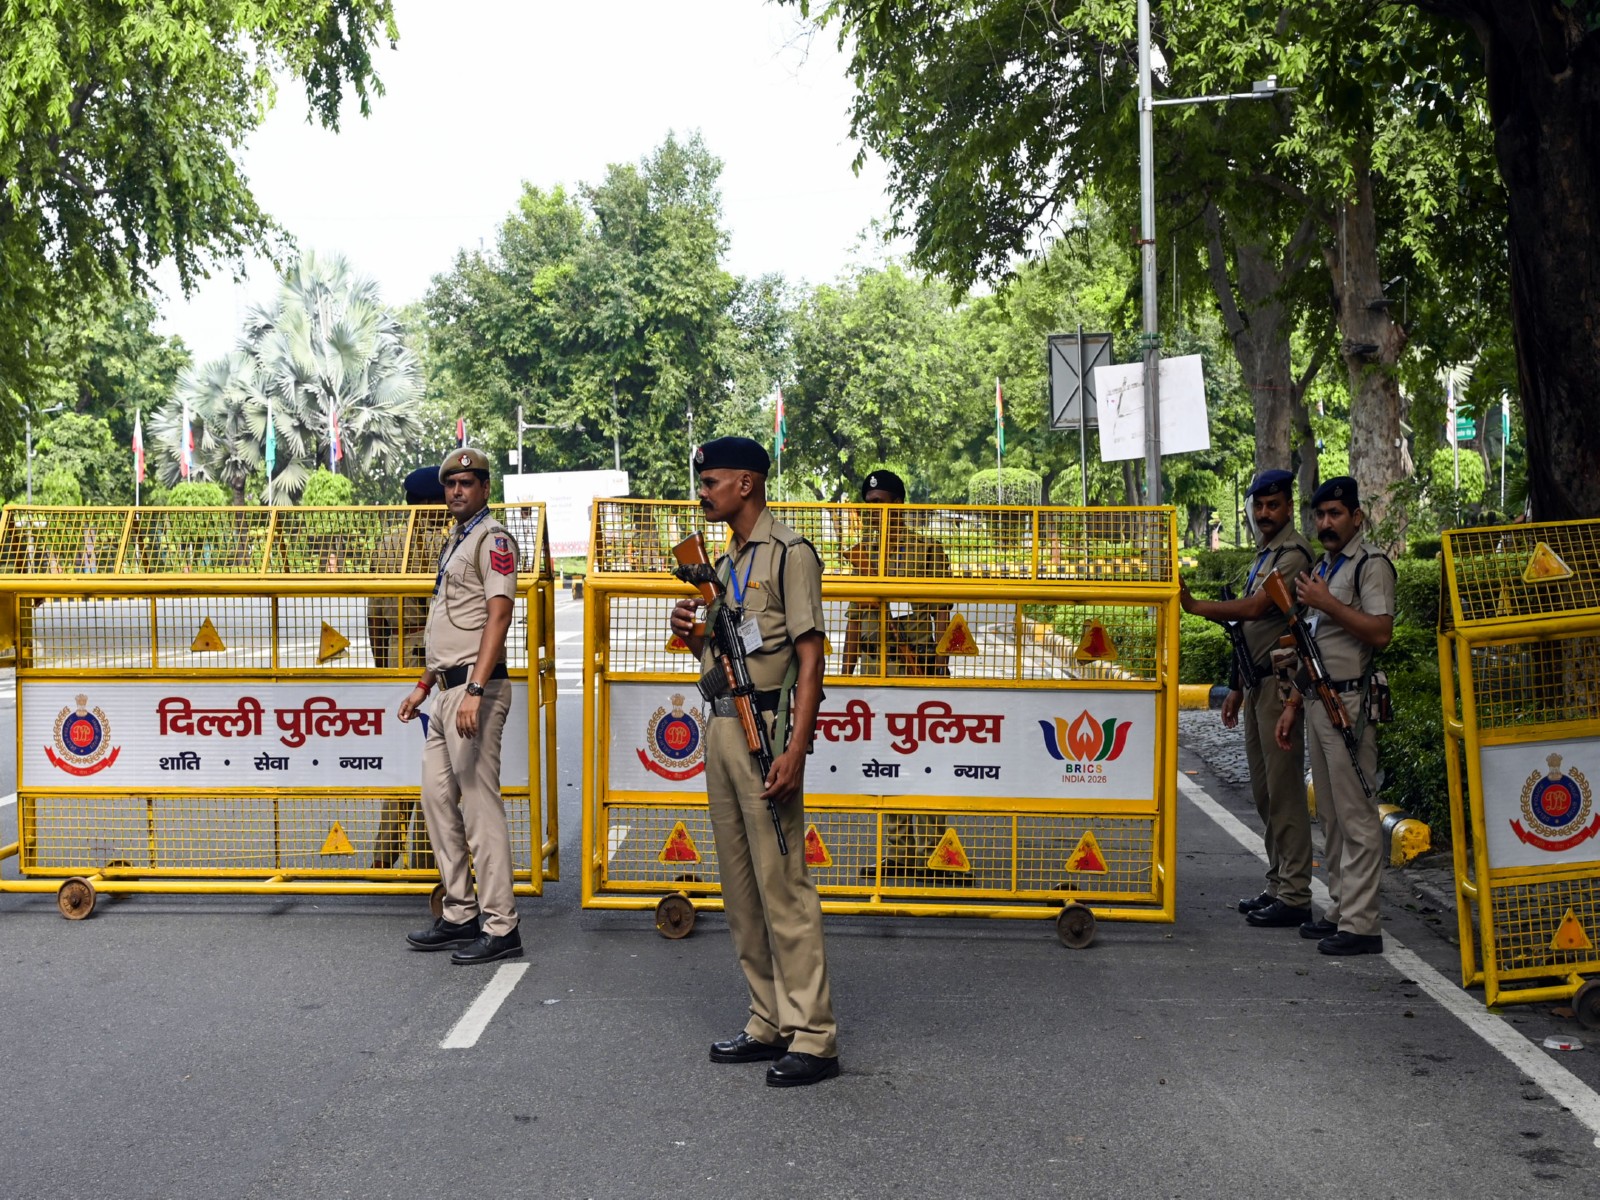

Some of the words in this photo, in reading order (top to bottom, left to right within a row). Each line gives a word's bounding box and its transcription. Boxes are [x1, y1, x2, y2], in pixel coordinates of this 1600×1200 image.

[156, 696, 265, 737] दिल्ली
[274, 696, 385, 748] पुलिस
[813, 699, 876, 742] ल्ली
[885, 701, 1005, 755] पुलिस
[159, 751, 201, 770] शांति
[254, 752, 289, 771] सेवा
[339, 756, 383, 770] न्याय
[862, 758, 901, 778] सेवा
[954, 764, 1001, 780] न्याय
[1066, 764, 1103, 773] BRICS
[1062, 775, 1086, 783] INDIA
[1087, 775, 1107, 783] 2026
